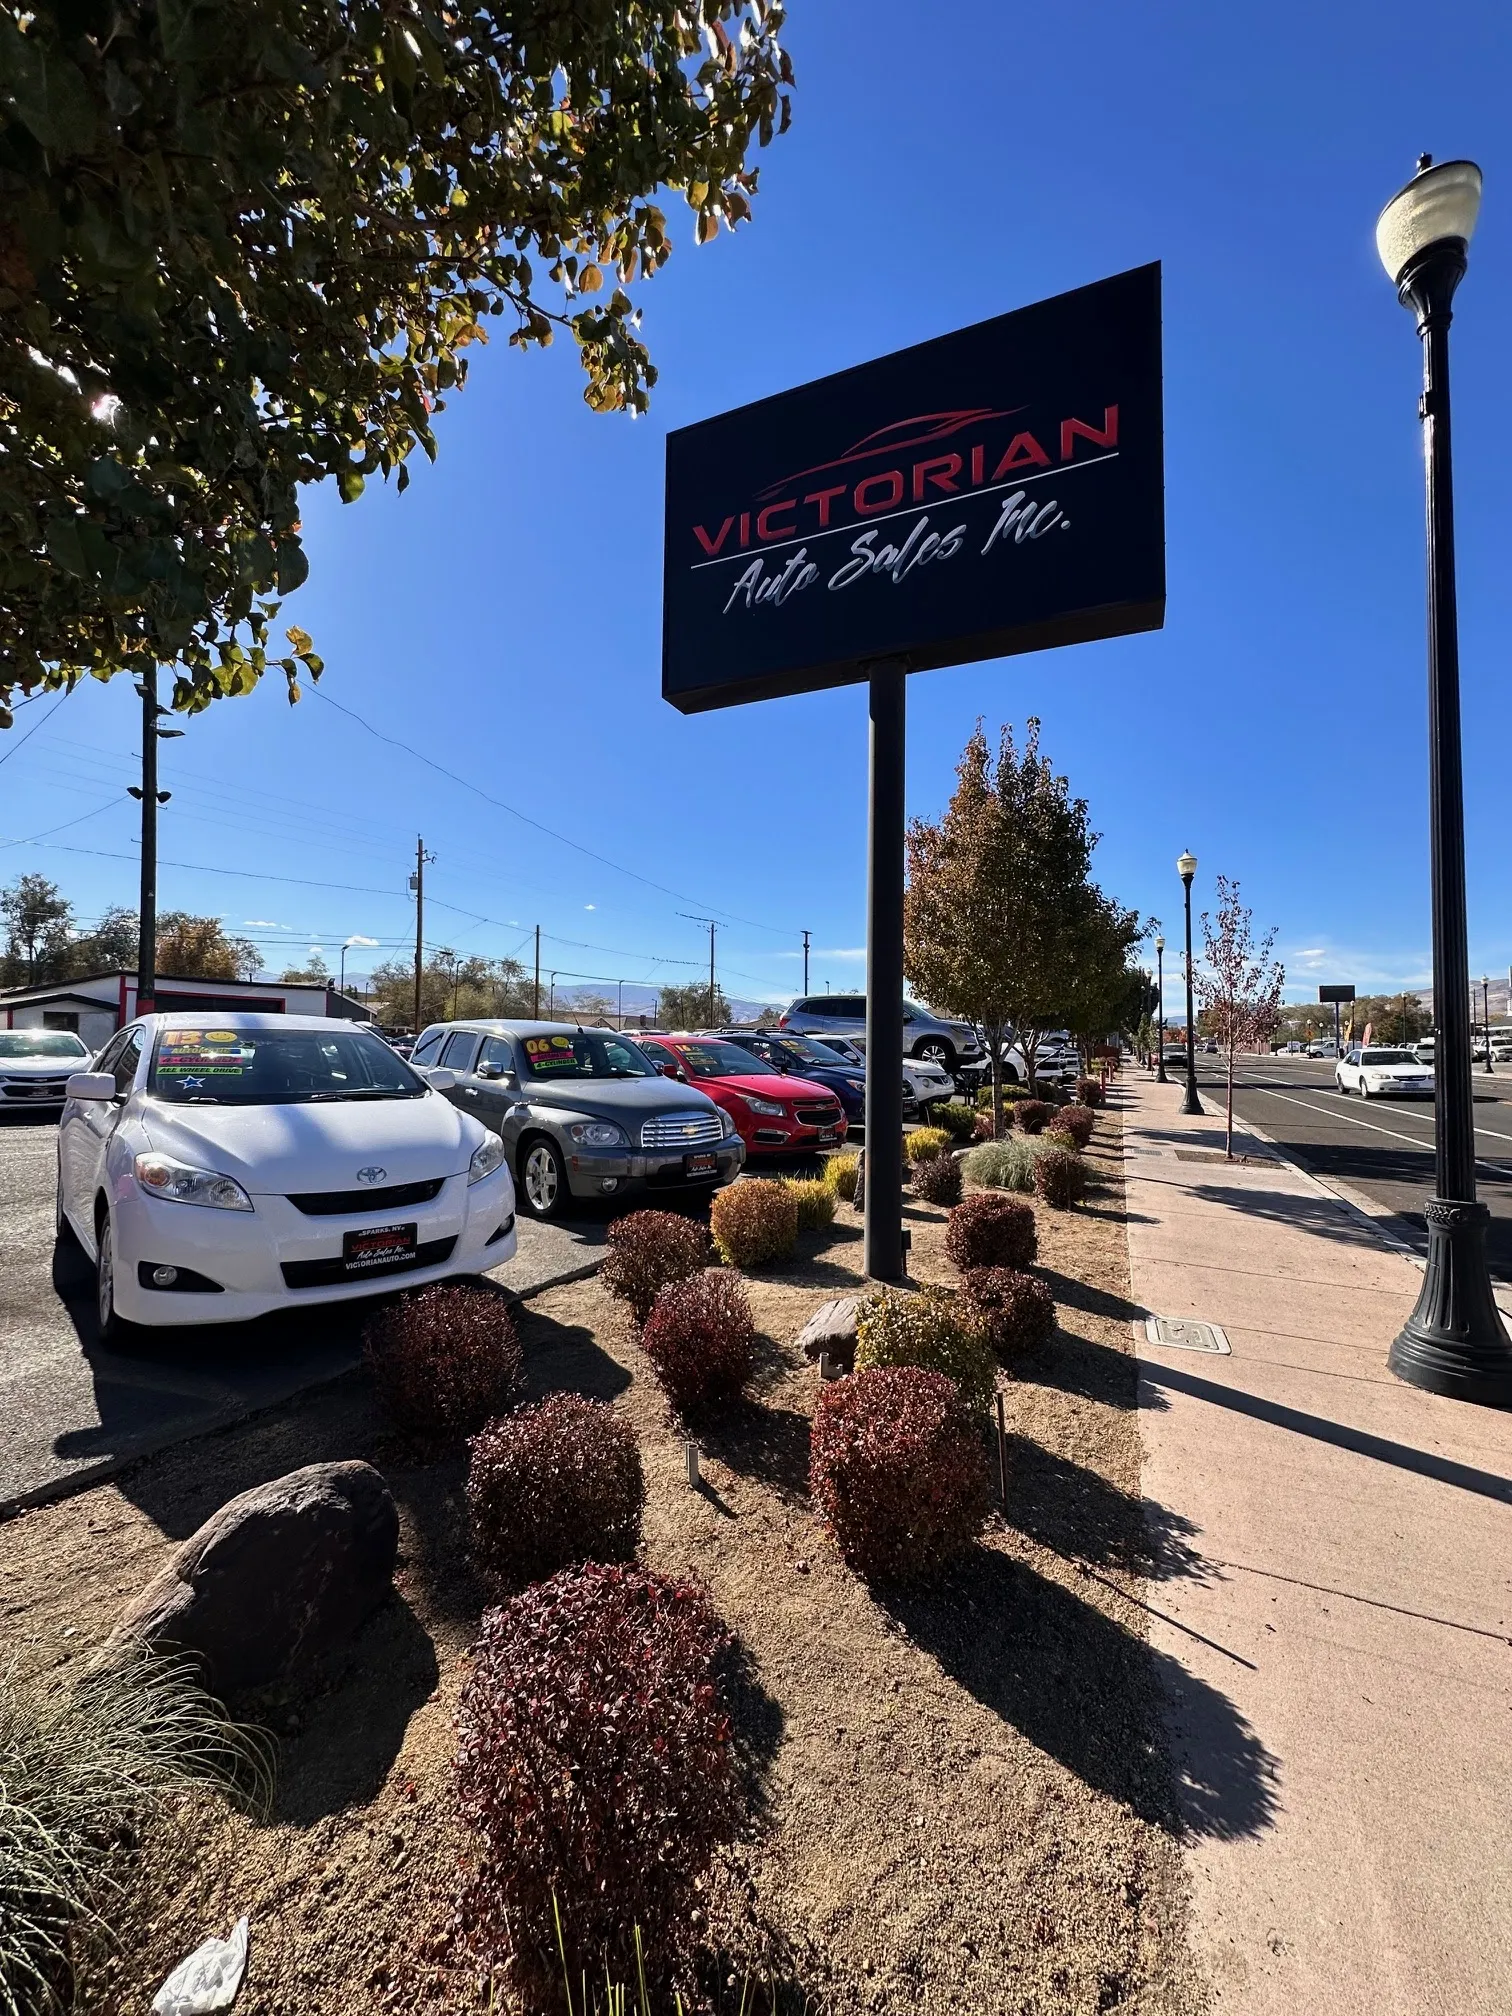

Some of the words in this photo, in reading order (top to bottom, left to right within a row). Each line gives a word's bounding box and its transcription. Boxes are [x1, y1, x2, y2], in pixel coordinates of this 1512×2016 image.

[692, 404, 1119, 556] VICTORIAN
[723, 547, 819, 614] Auto
[828, 516, 967, 591] Sales
[981, 490, 1071, 556] Inc.
[163, 1030, 202, 1045] 13
[526, 1039, 550, 1054] 06
[352, 1236, 411, 1250] VICTORIAN
[345, 1252, 416, 1270] VICTORIANAUTO.COM
